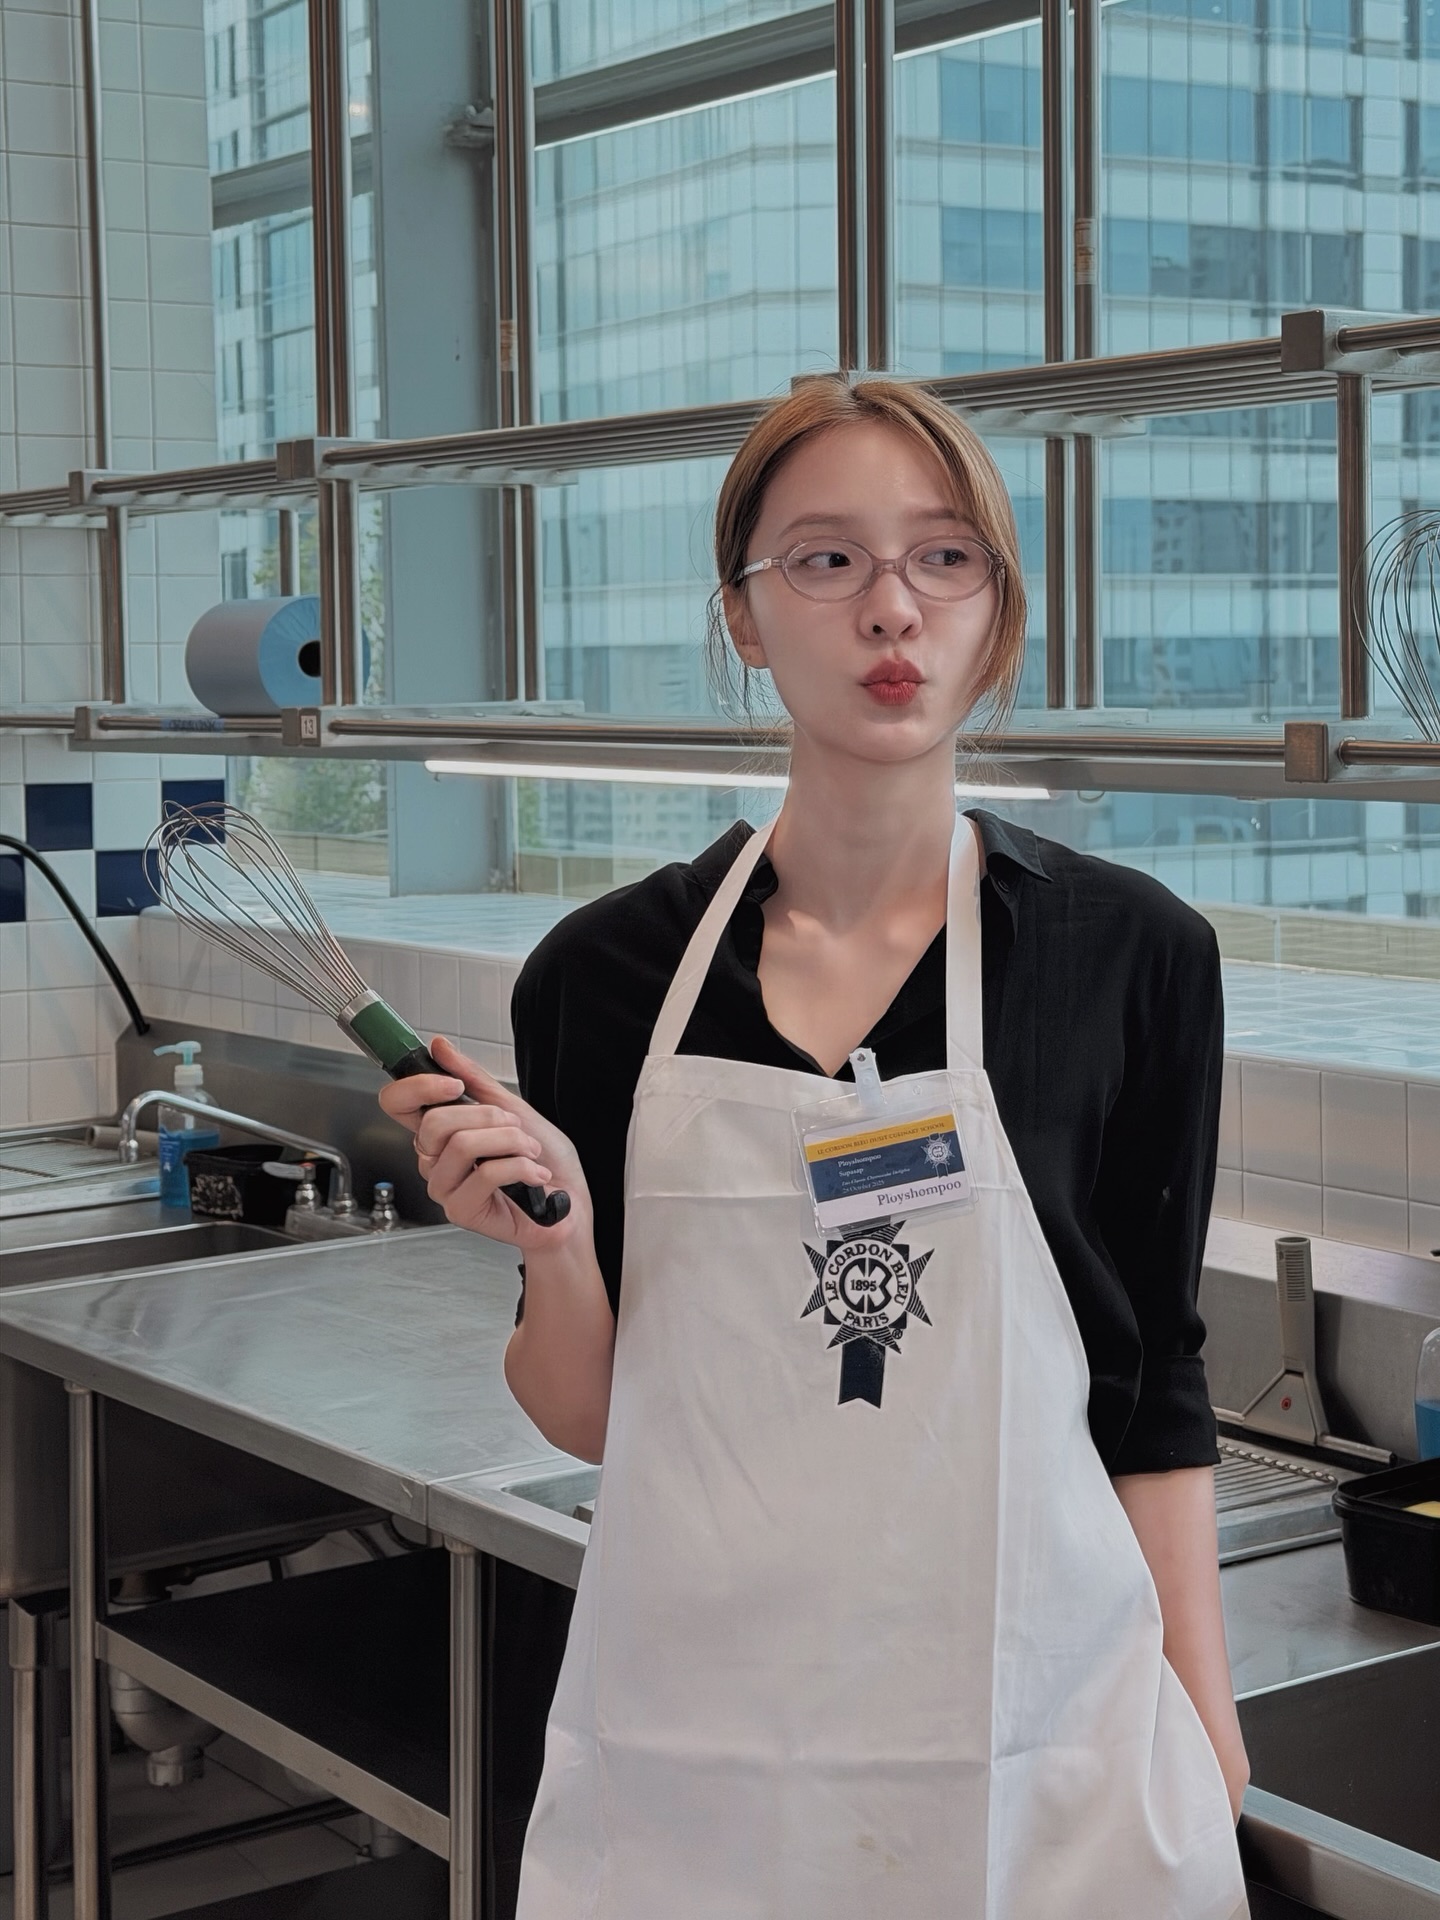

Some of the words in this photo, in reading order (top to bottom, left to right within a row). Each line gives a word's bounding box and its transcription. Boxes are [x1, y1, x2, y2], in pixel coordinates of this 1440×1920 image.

[304, 719, 314, 735] 13
[877, 1180, 962, 1206] Ployshompoo
[828, 1243, 894, 1276] CORDON
[825, 1280, 840, 1303] LE
[850, 1279, 877, 1292] 1895
[890, 1260, 909, 1306] BLEU
[843, 1310, 890, 1328] PARIS
